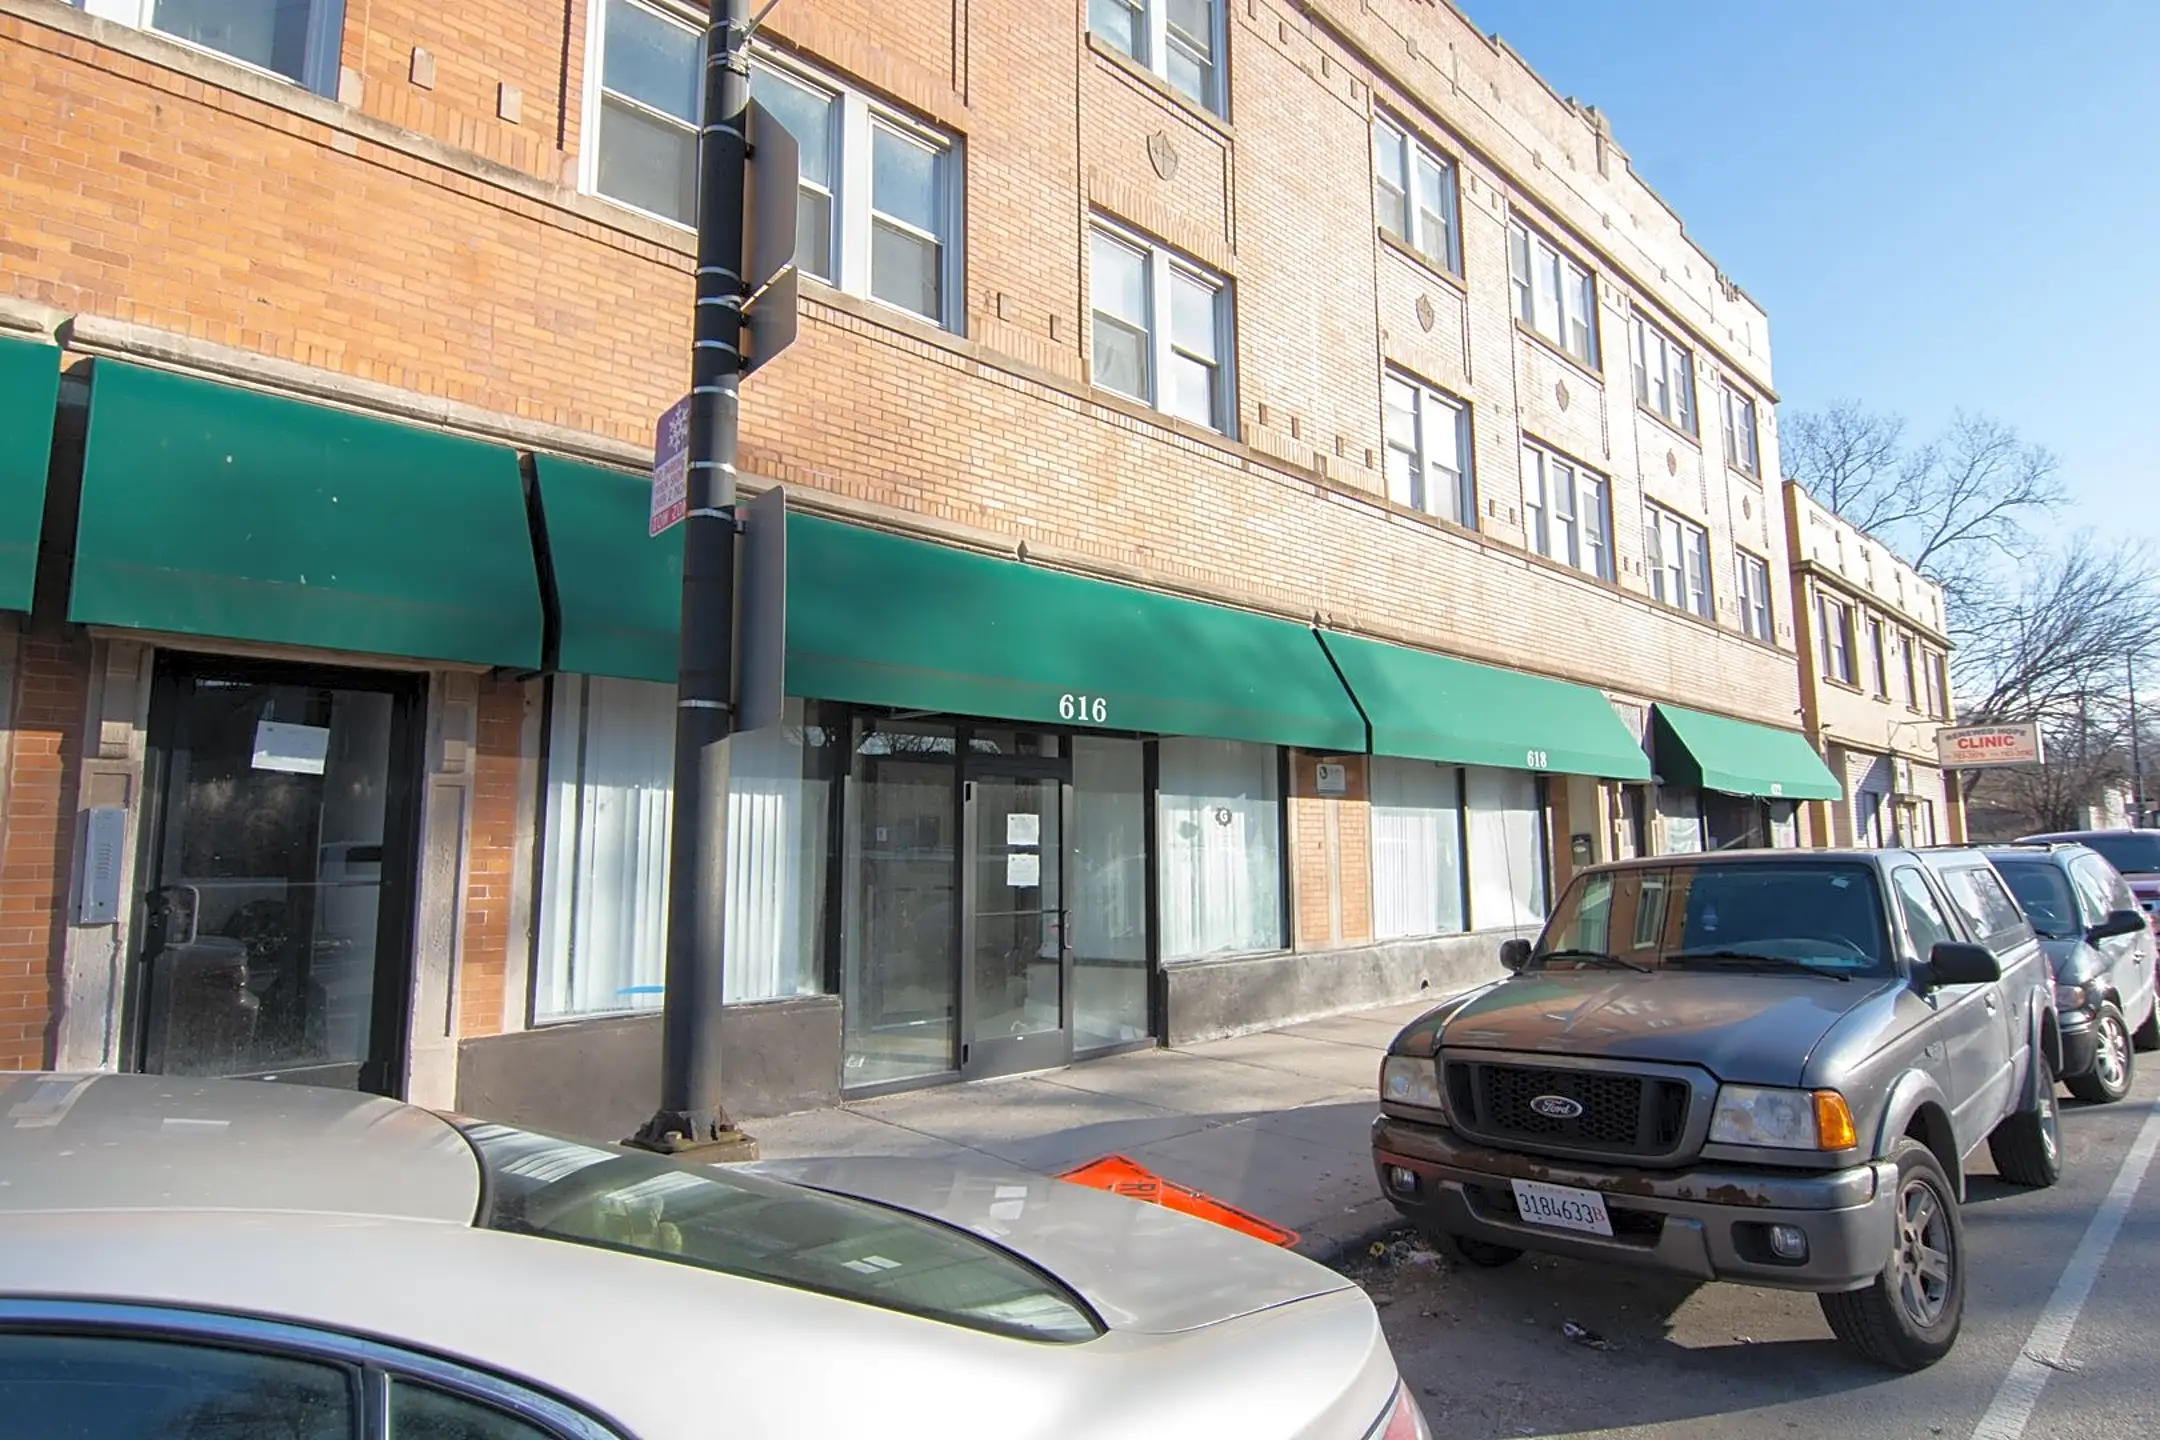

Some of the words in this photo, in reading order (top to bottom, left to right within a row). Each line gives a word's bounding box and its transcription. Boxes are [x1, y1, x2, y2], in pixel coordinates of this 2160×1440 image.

[1059, 694, 1107, 723] 616
[1957, 735, 2016, 750] CLINIC
[1527, 749, 1548, 768] 618
[1542, 1099, 1572, 1115] Ford
